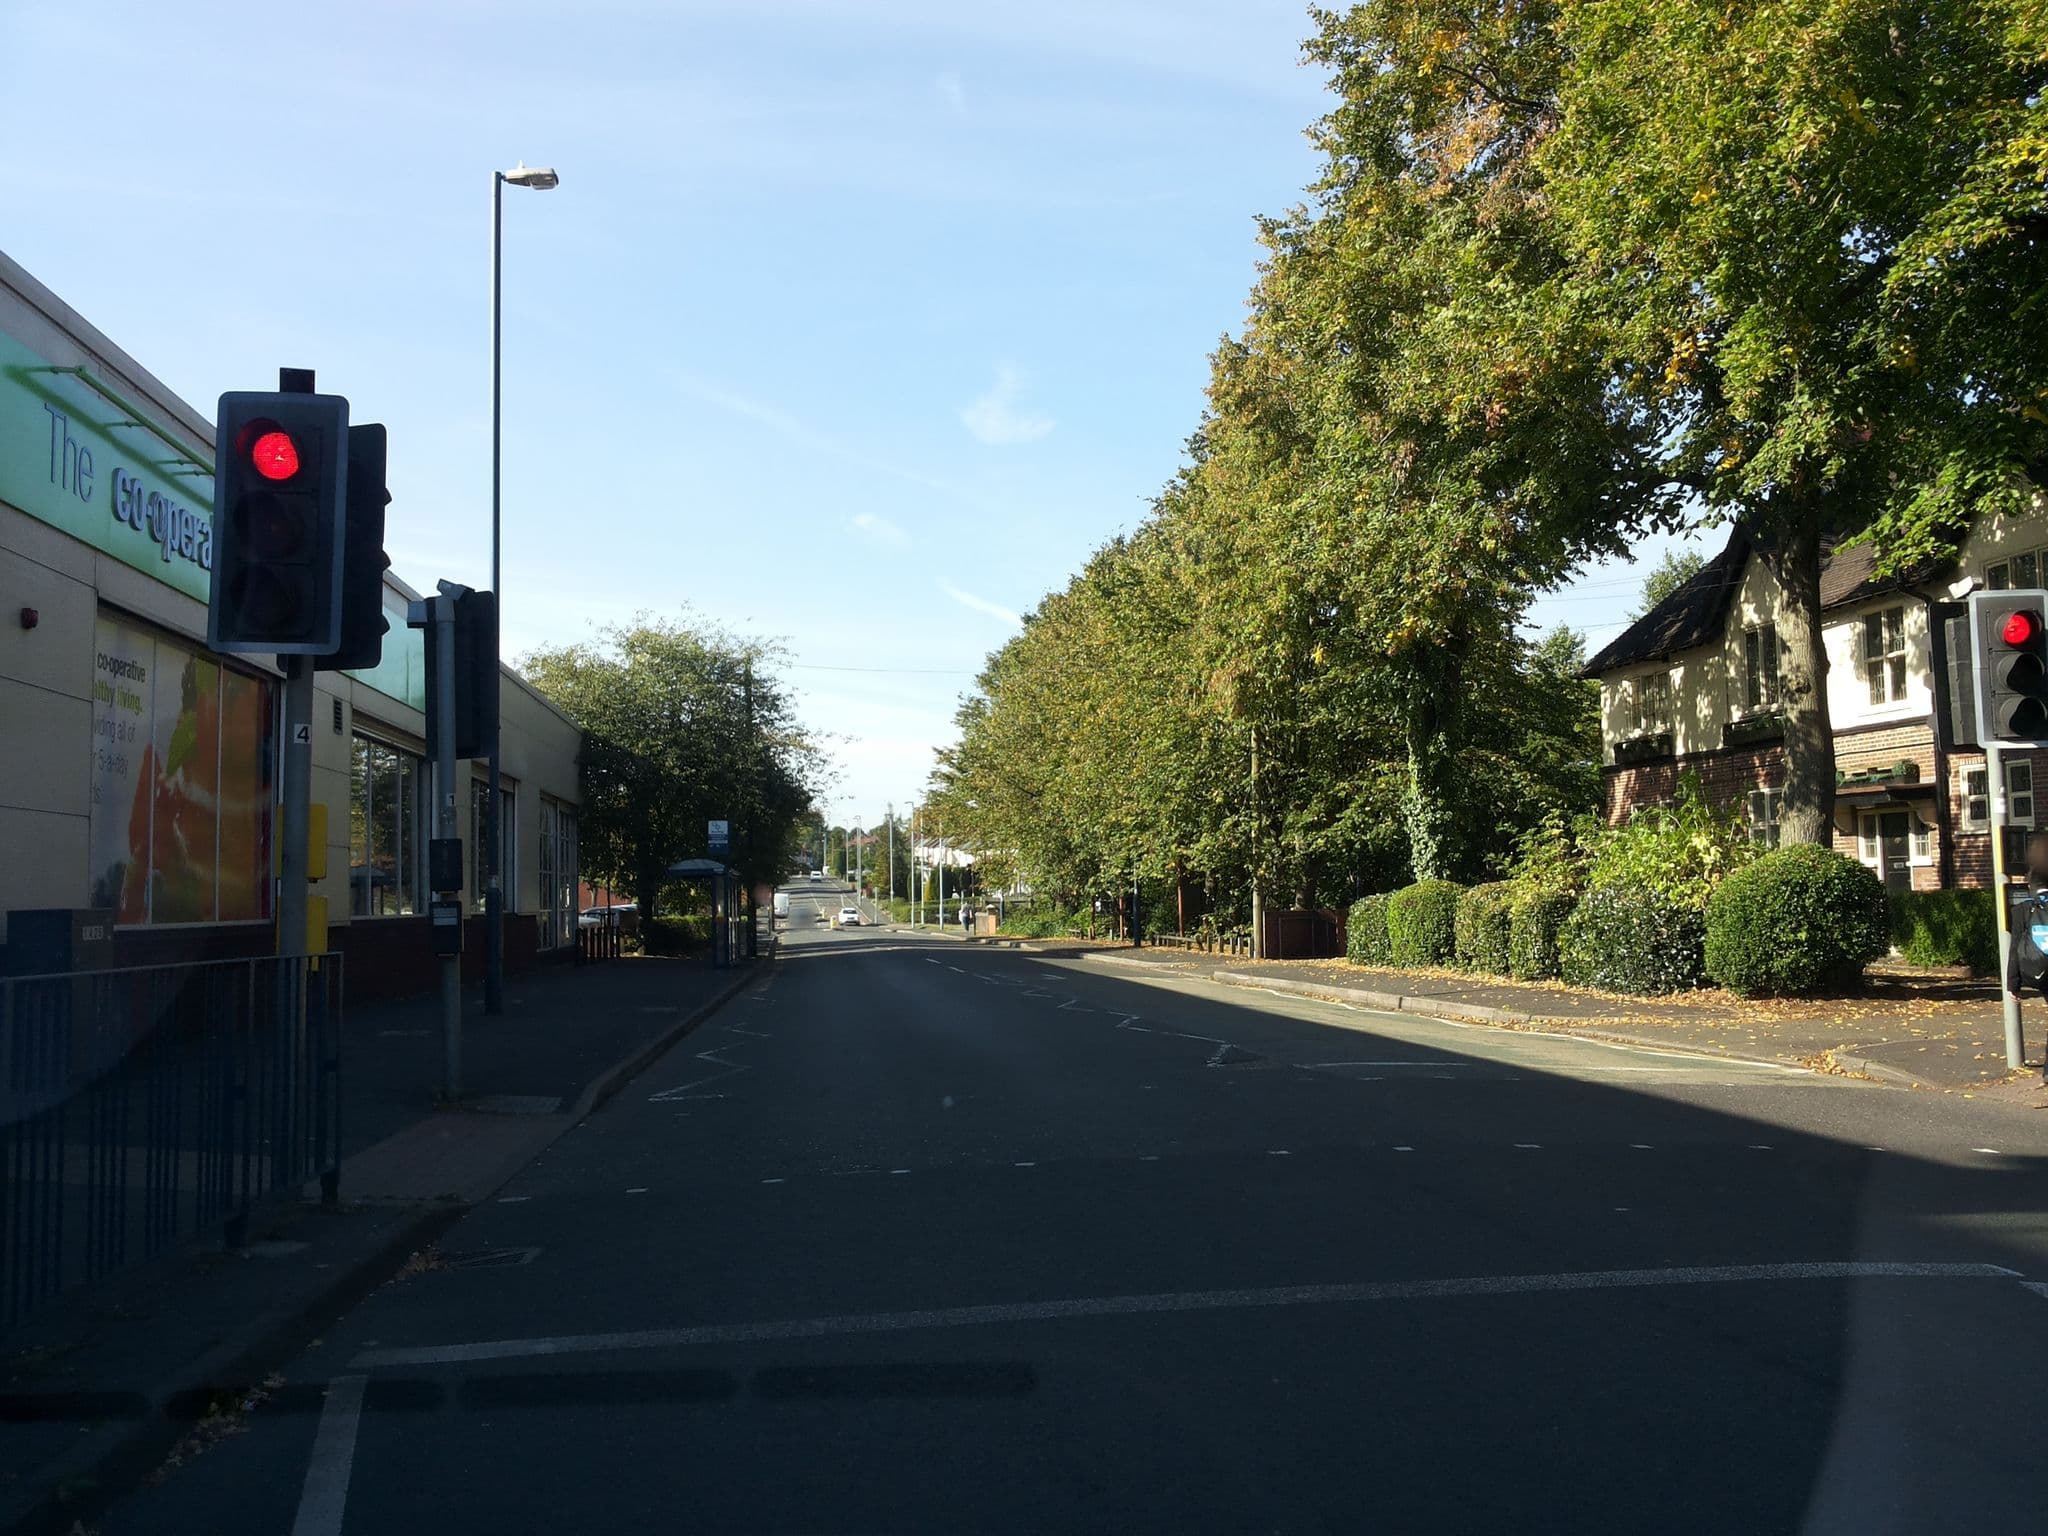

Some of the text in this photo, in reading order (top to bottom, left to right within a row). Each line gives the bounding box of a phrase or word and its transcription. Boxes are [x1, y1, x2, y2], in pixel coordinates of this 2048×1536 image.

[44, 402, 214, 569] The co-opera
[97, 652, 146, 683] co-operative
[297, 725, 310, 743] 4
